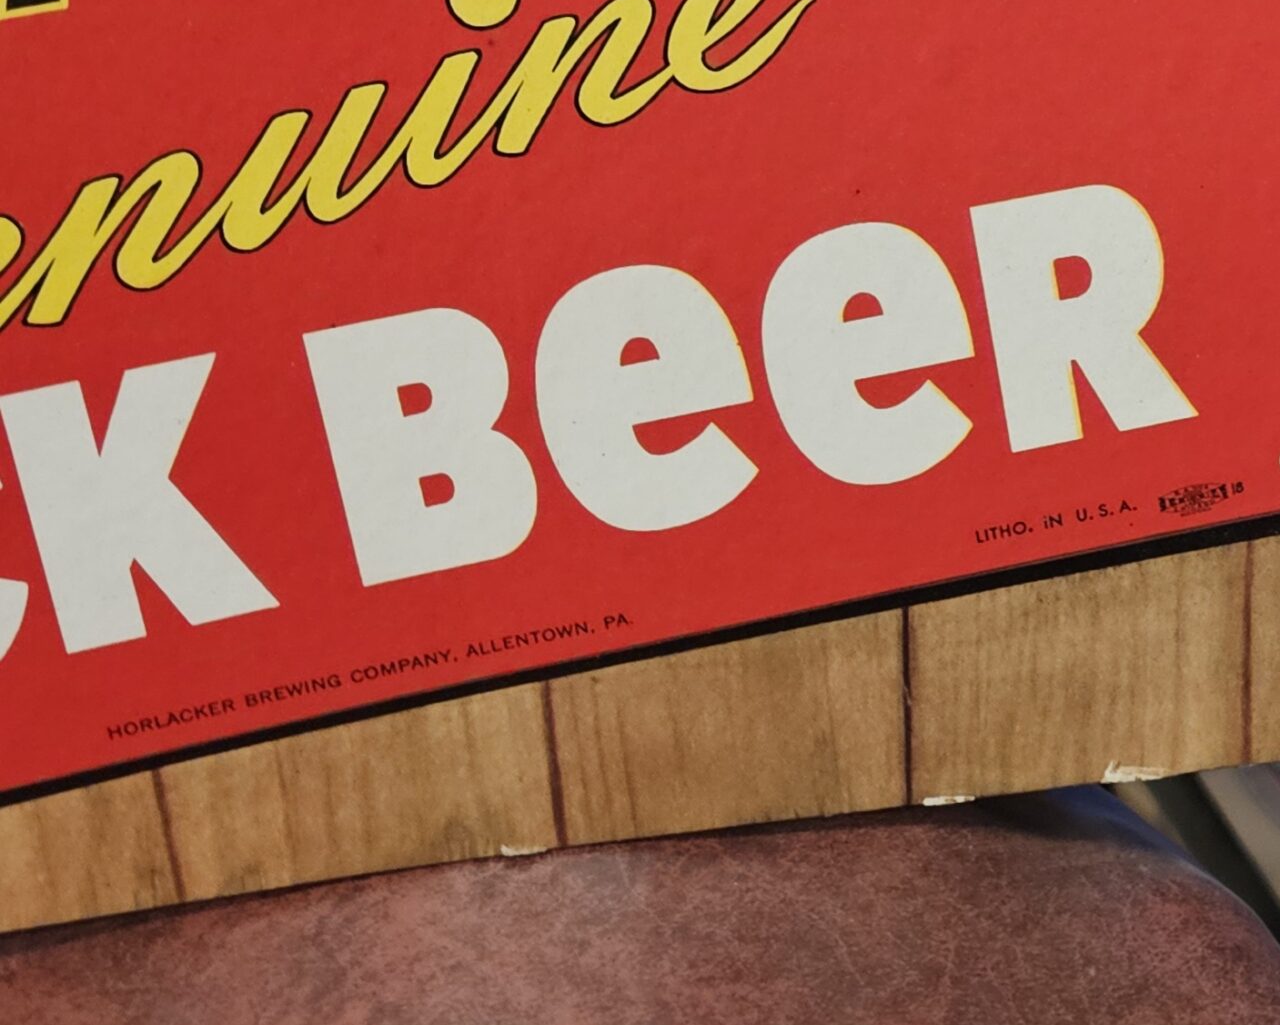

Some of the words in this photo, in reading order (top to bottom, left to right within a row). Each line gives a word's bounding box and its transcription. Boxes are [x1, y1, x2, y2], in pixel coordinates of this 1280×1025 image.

[0, 352, 280, 660] K
[975, 521, 1033, 544] LITHO.
[106, 698, 236, 740] HORLACKER
[244, 673, 343, 708] BREWING
[350, 649, 458, 684] COMPANY,
[466, 621, 595, 658] ALLENTOWN,
